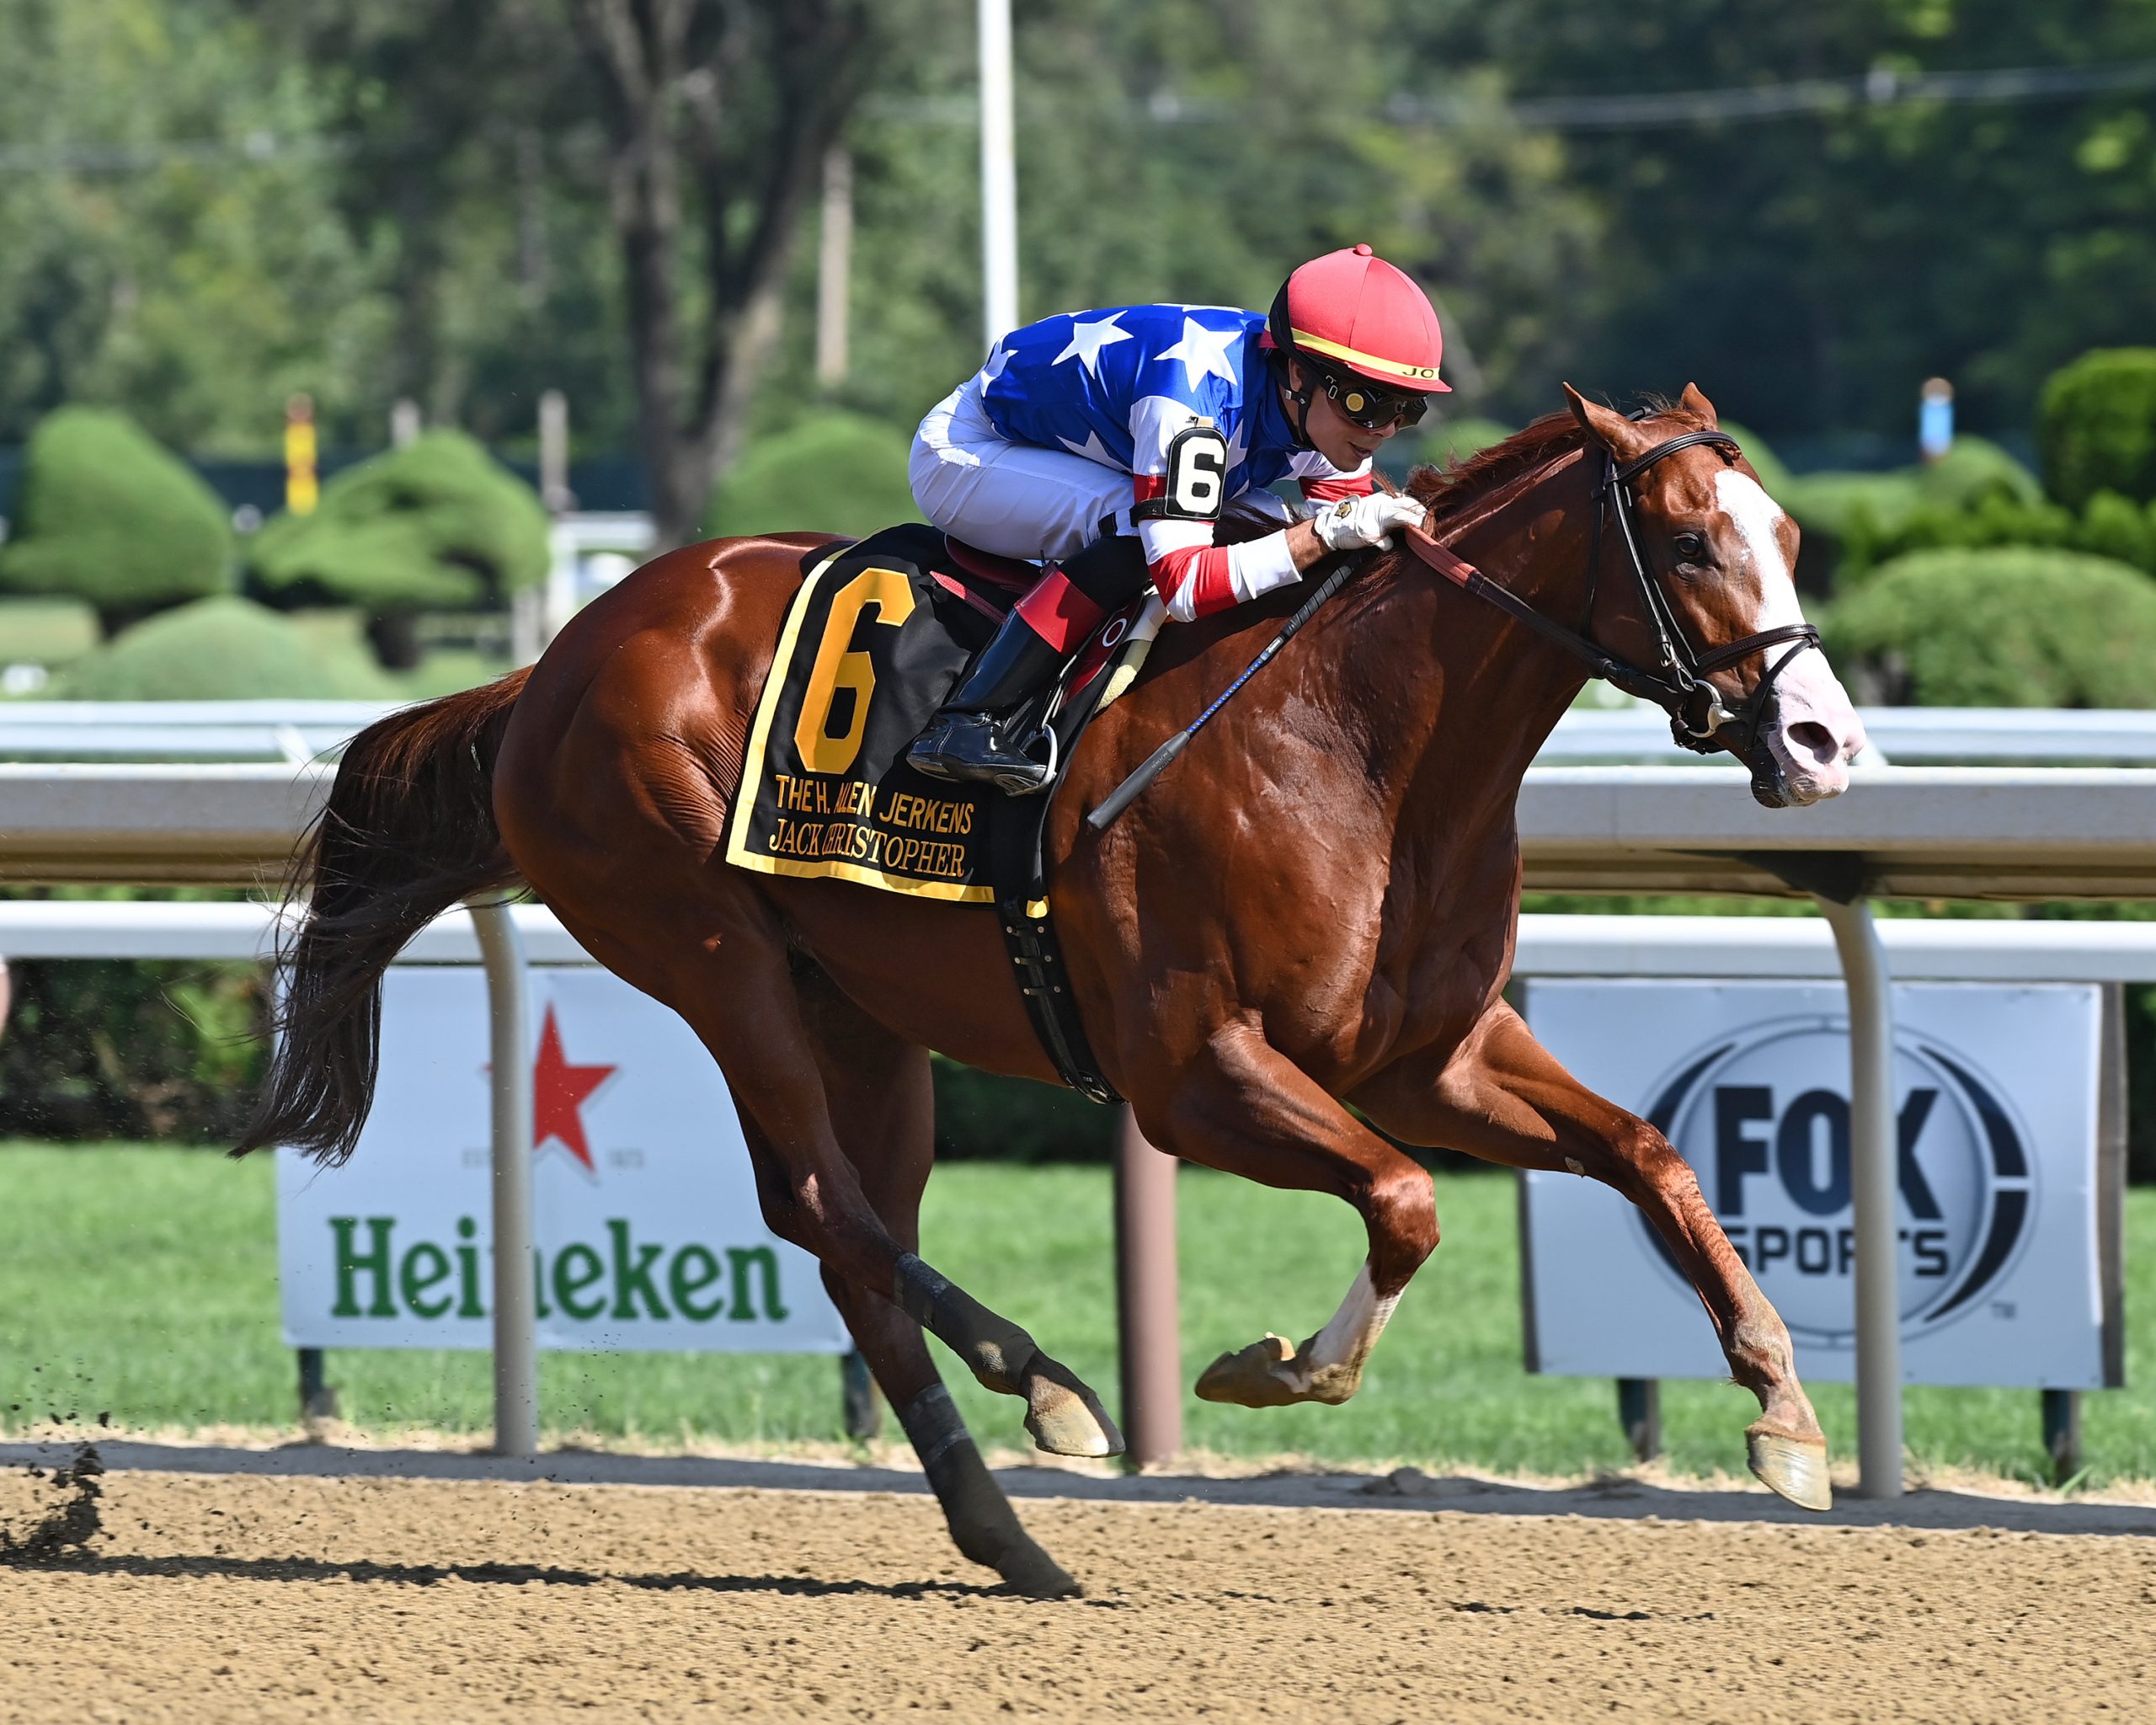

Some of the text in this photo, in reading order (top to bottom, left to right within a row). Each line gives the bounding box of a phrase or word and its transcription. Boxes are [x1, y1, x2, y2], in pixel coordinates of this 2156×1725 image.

[1176, 436, 1225, 514] 6
[794, 567, 915, 774] 6
[775, 774, 814, 813] THE
[878, 791, 974, 835] JERKENS
[769, 818, 965, 878] JACK CHRISTOPHER
